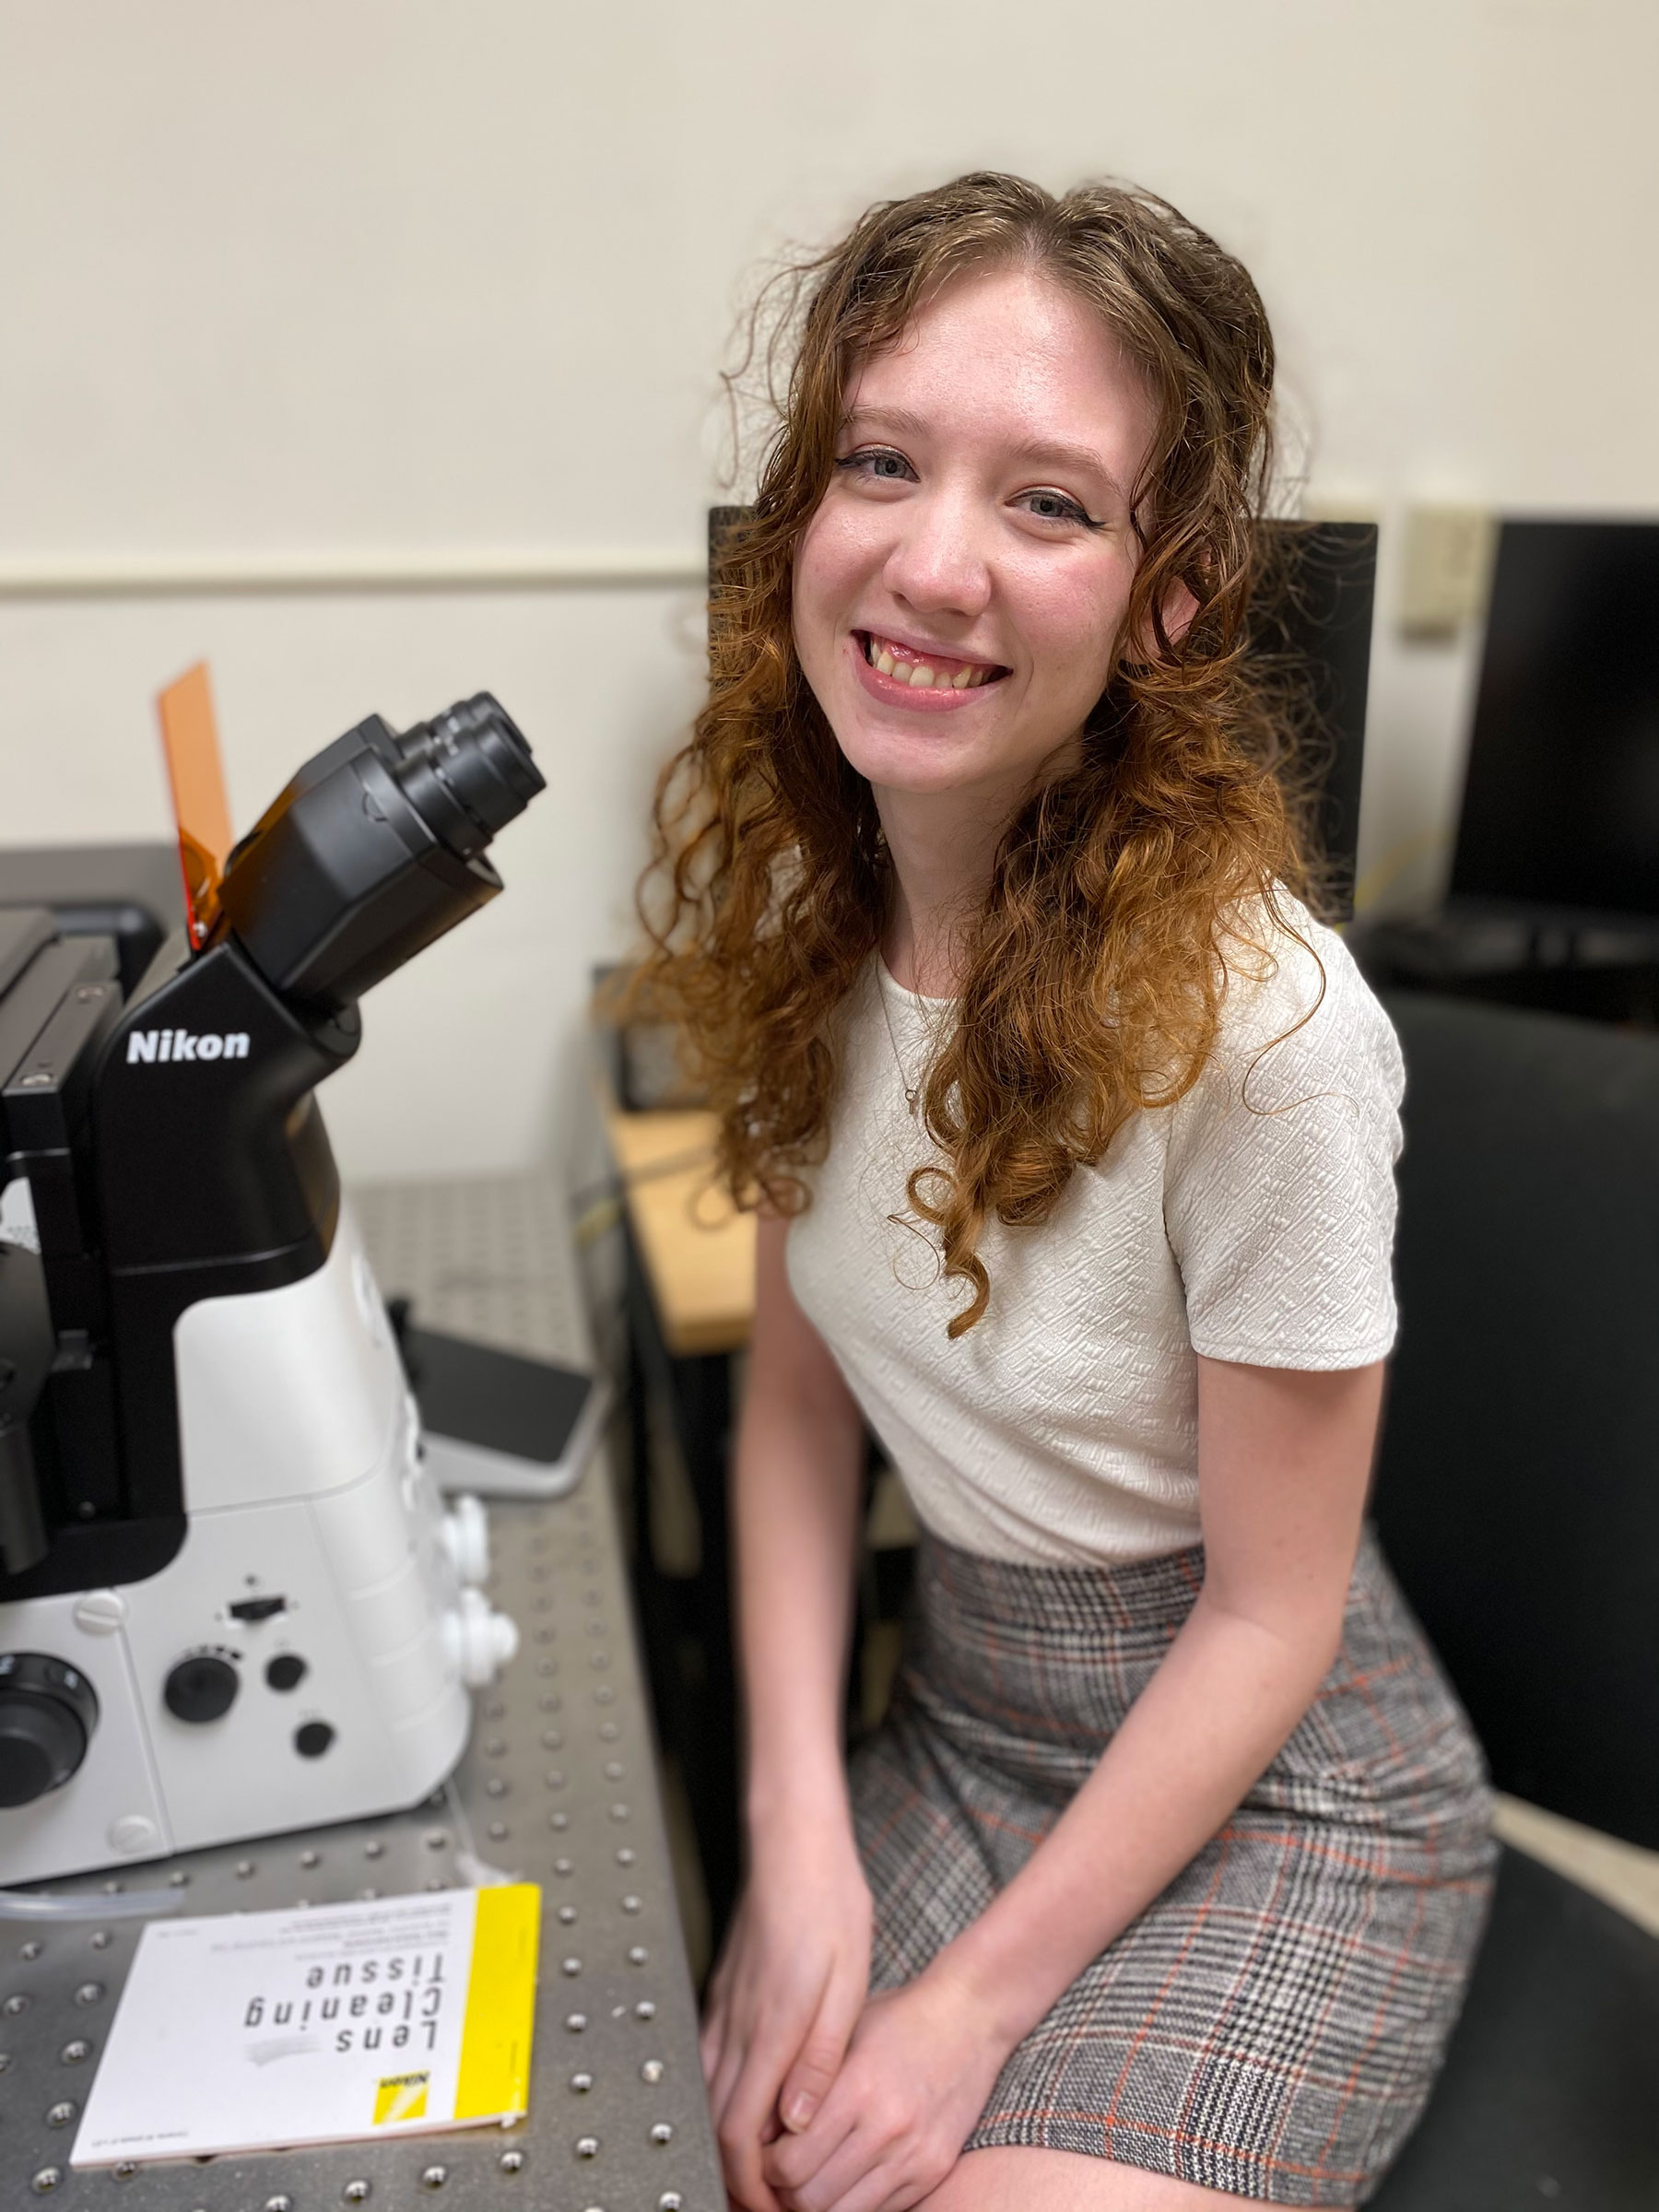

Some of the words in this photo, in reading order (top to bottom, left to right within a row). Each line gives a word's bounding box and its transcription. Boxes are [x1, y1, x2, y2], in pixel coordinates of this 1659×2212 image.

[126, 1029, 251, 1064] Nikon
[306, 1954, 445, 1988] Tissue
[244, 1986, 441, 2031] Cleaning
[335, 2020, 438, 2053] Lens
[379, 2072, 430, 2088] Nikon
